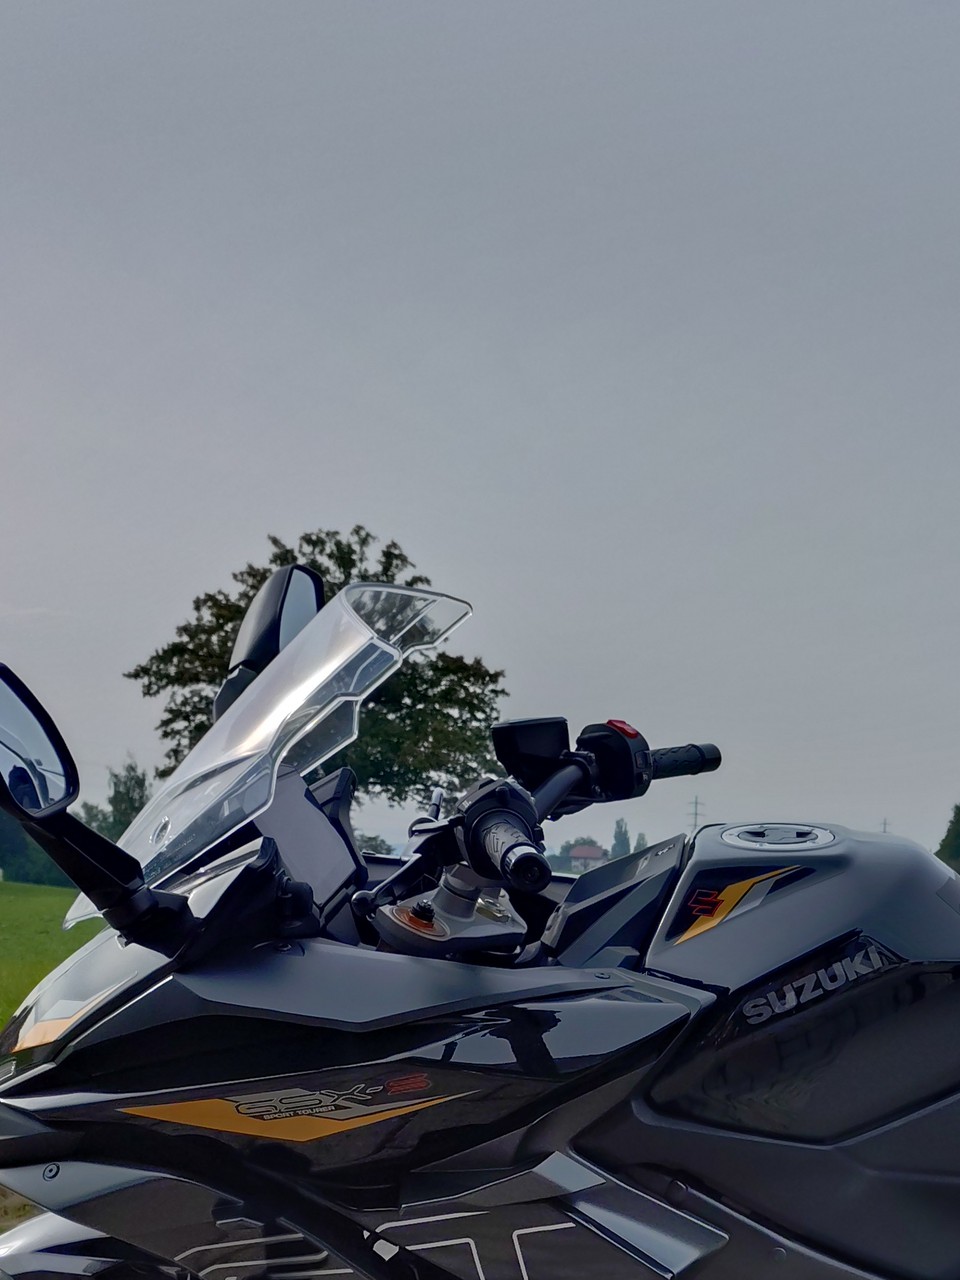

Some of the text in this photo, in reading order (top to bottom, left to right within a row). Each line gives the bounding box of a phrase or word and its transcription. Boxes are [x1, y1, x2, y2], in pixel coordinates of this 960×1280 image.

[742, 945, 883, 1025] SUZUKI
[234, 1072, 432, 1116] GSX-S
[263, 1105, 336, 1121] SPORT TOURER
